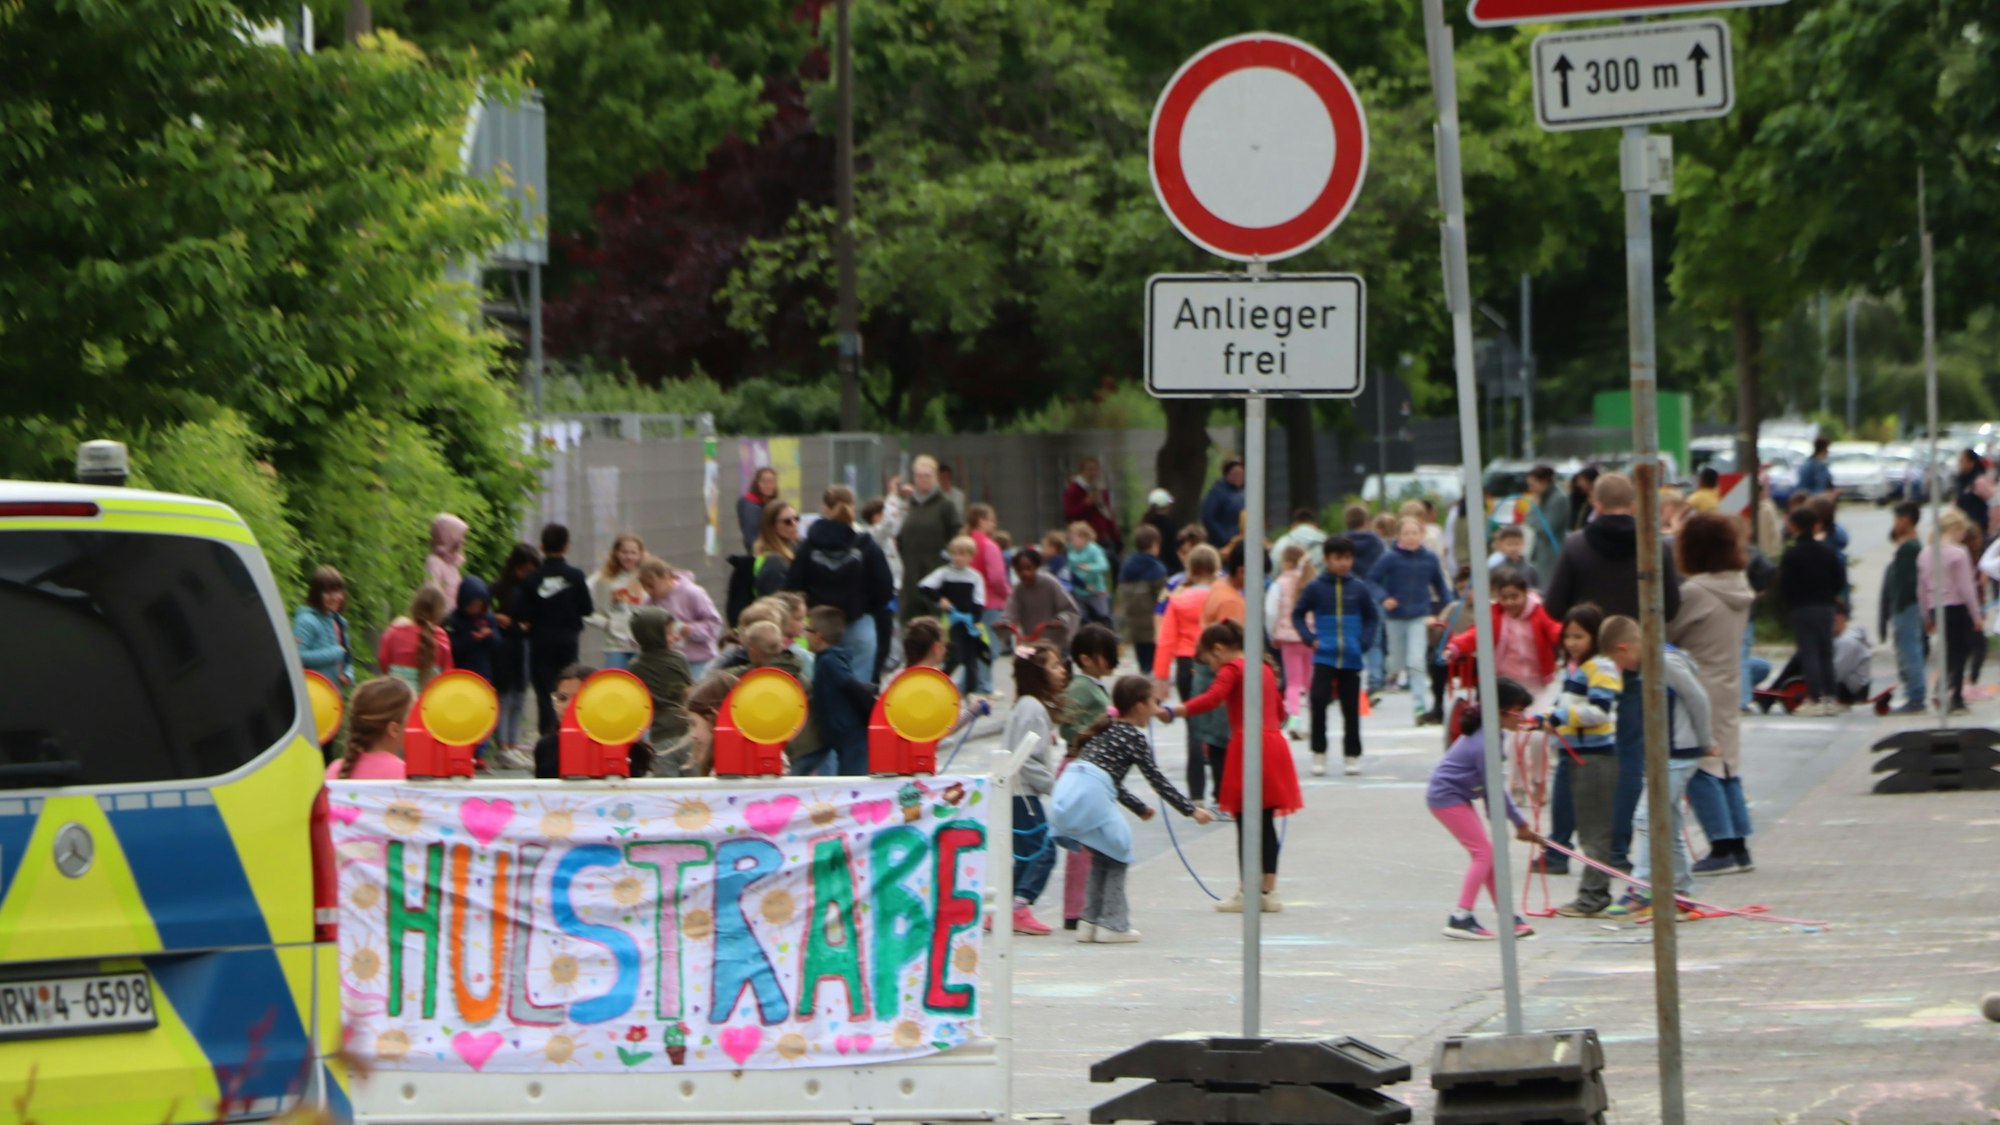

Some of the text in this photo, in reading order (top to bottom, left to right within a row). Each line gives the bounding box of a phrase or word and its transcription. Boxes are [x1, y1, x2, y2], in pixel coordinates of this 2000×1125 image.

[1585, 56, 1679, 95] 300 m
[1173, 296, 1337, 338] Anlieger
[1223, 342, 1287, 375] frei
[0, 978, 150, 1025] RW 4-6598
